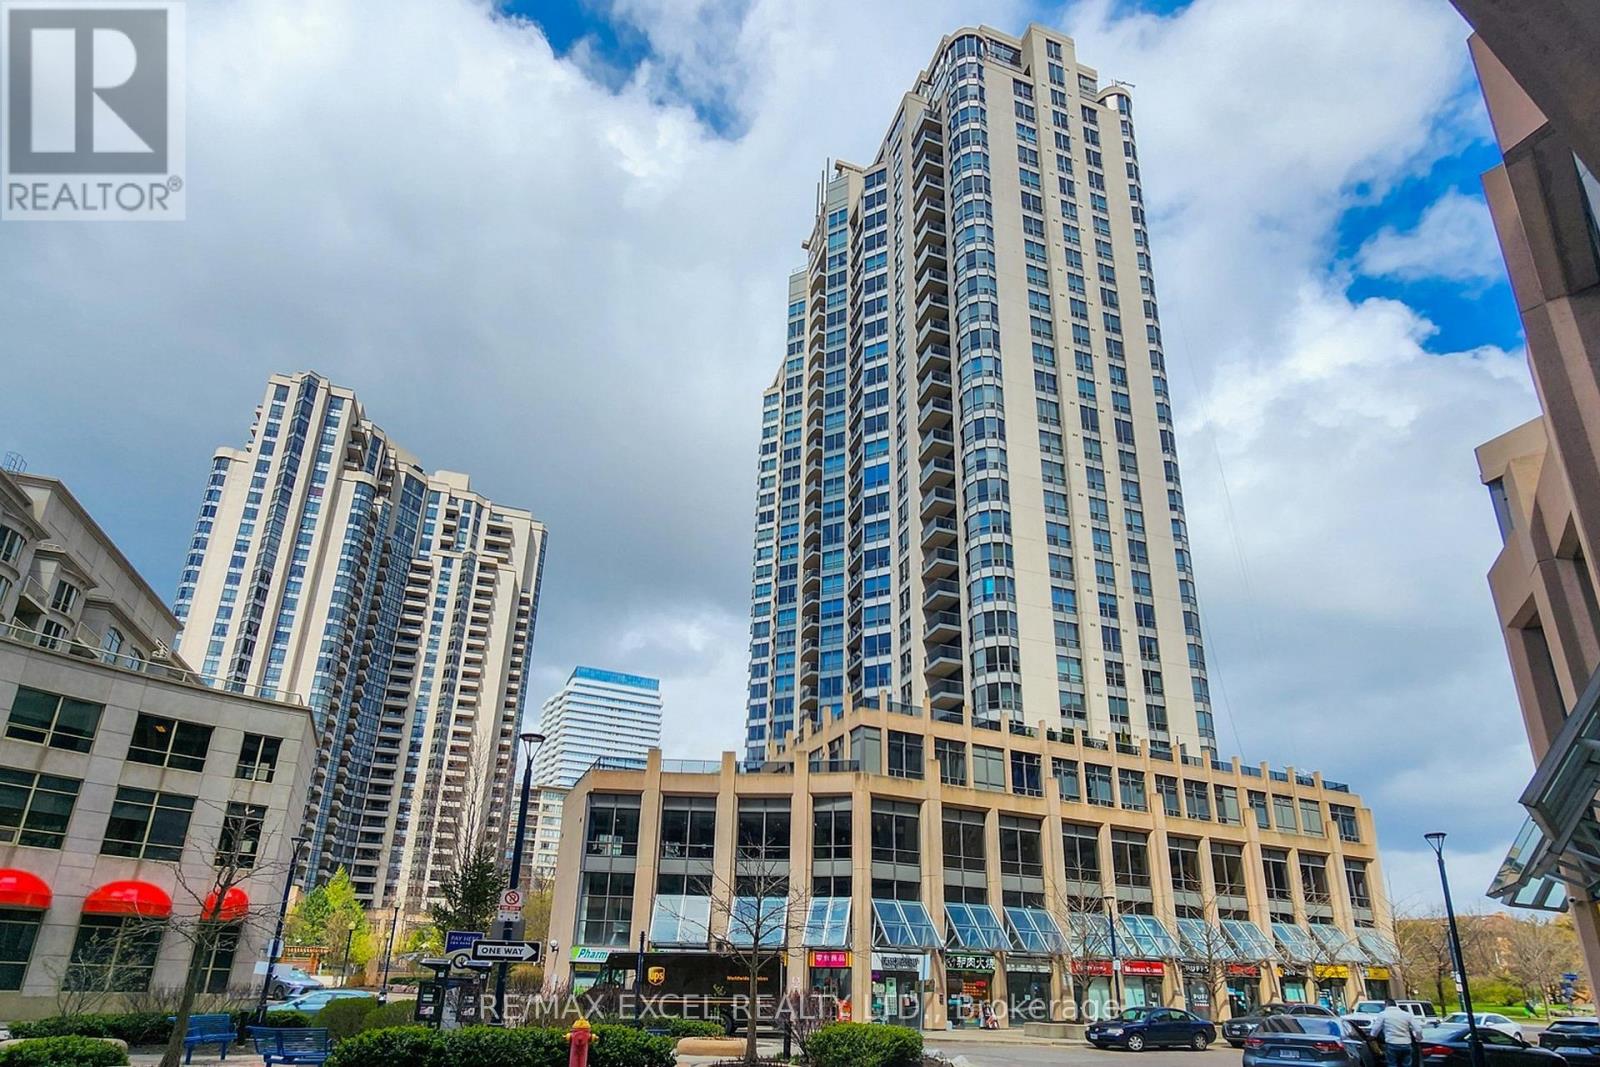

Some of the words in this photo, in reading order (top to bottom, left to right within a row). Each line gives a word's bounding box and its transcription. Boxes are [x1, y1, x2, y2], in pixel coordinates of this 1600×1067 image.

[481, 947, 502, 955] ONE
[503, 948, 524, 956] WAY
[649, 972, 664, 983] ups
